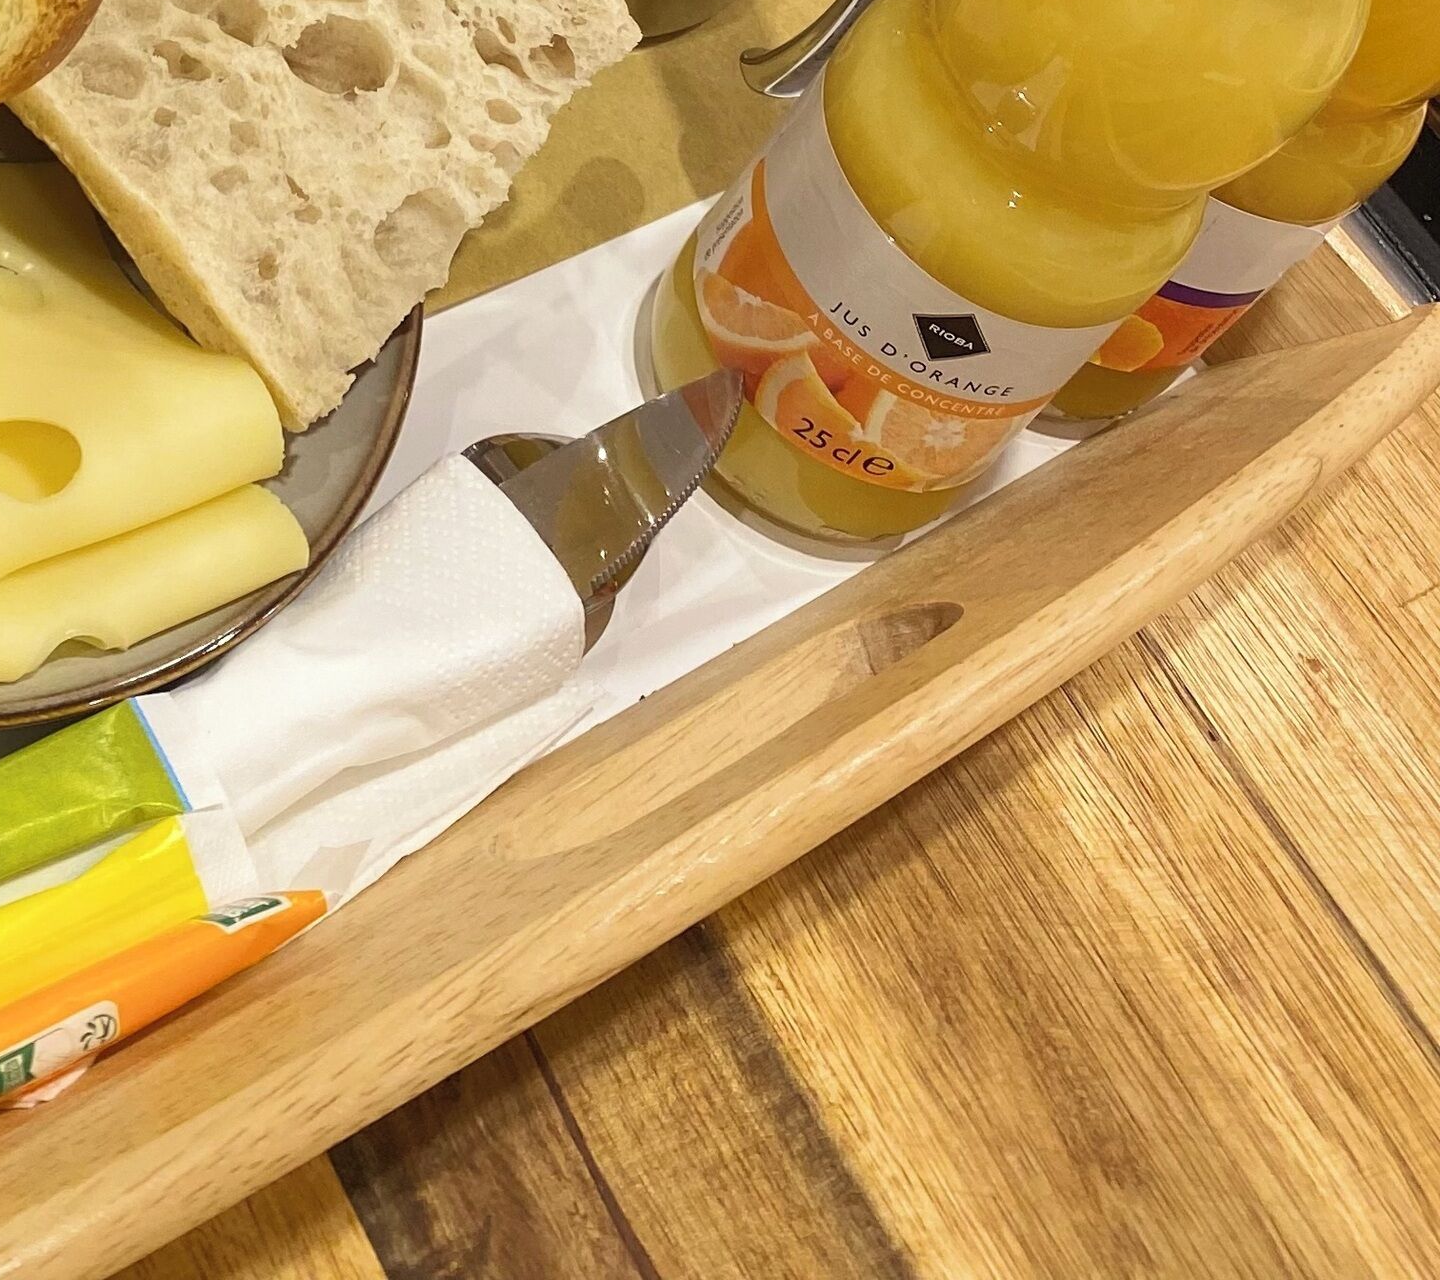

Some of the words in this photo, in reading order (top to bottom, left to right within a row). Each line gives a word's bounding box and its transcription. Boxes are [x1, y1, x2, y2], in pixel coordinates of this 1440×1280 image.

[823, 328, 863, 365] BASE
[867, 365, 892, 385] DE
[830, 302, 871, 337] JUS
[880, 342, 1014, 397] D'ORANGE
[928, 323, 974, 351] RIOBA
[792, 417, 833, 449] 25
[832, 446, 862, 465] cl
